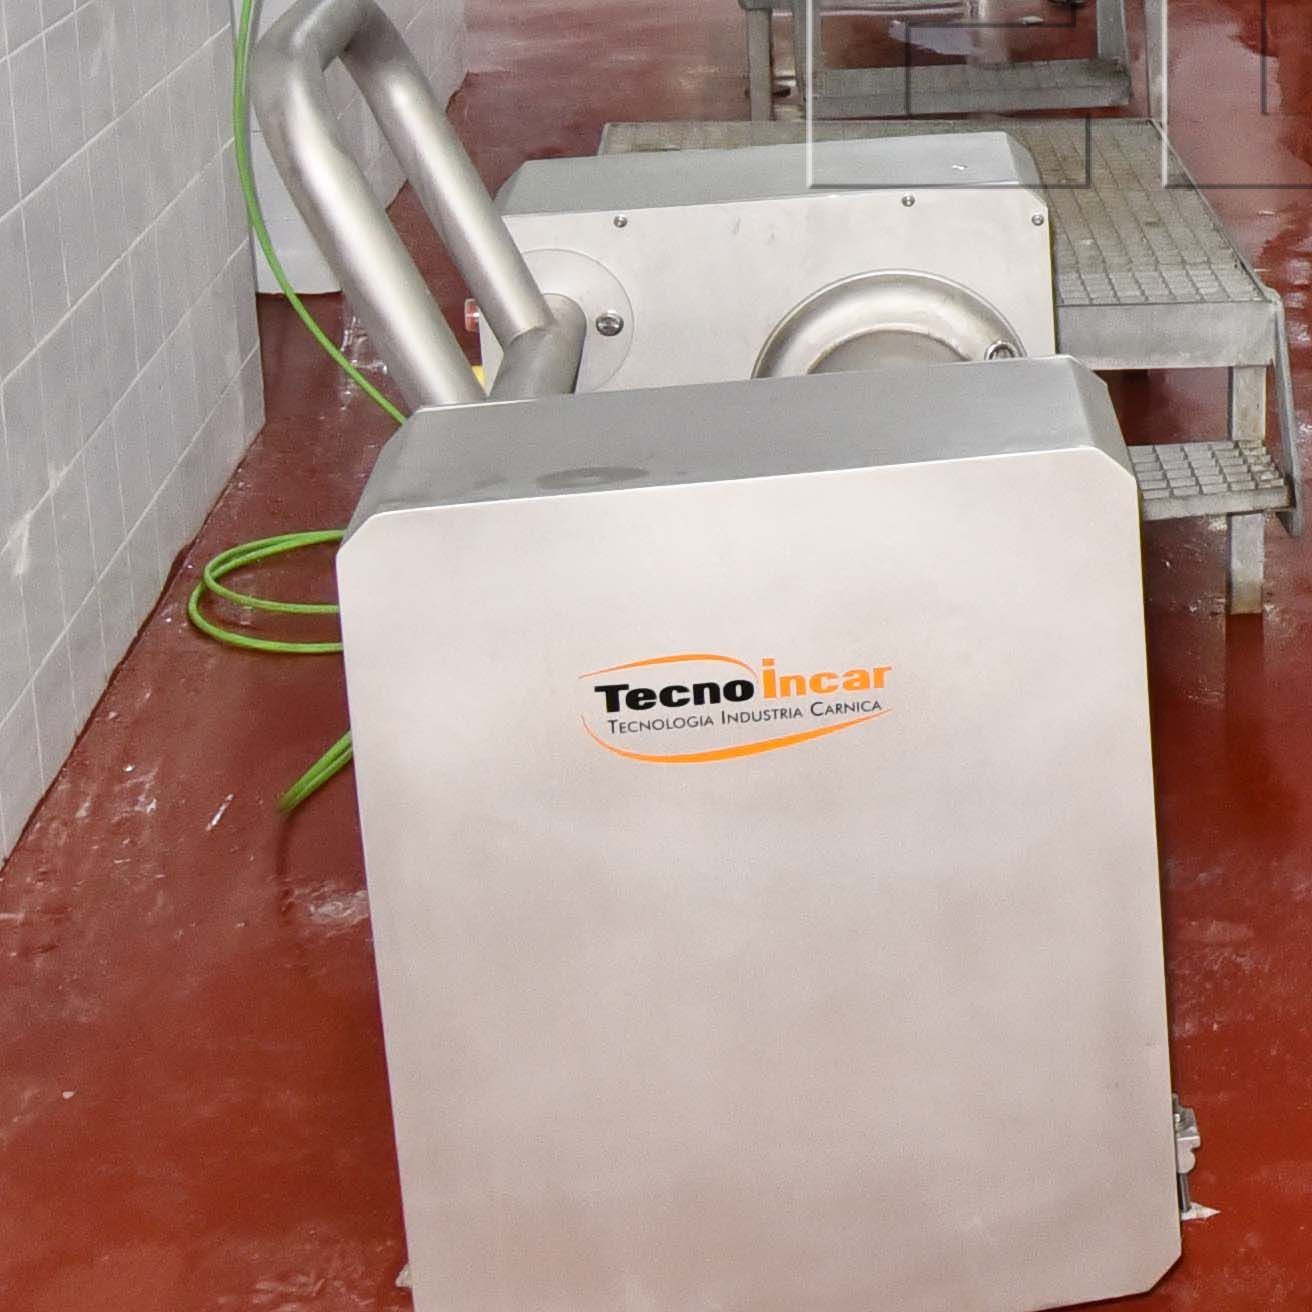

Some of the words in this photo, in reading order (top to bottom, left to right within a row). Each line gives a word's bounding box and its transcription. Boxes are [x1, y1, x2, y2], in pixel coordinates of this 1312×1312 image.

[607, 715, 714, 735] TECNOLOGIA
[721, 707, 803, 725] INDUSTRIA
[810, 700, 882, 717] CARNICA
